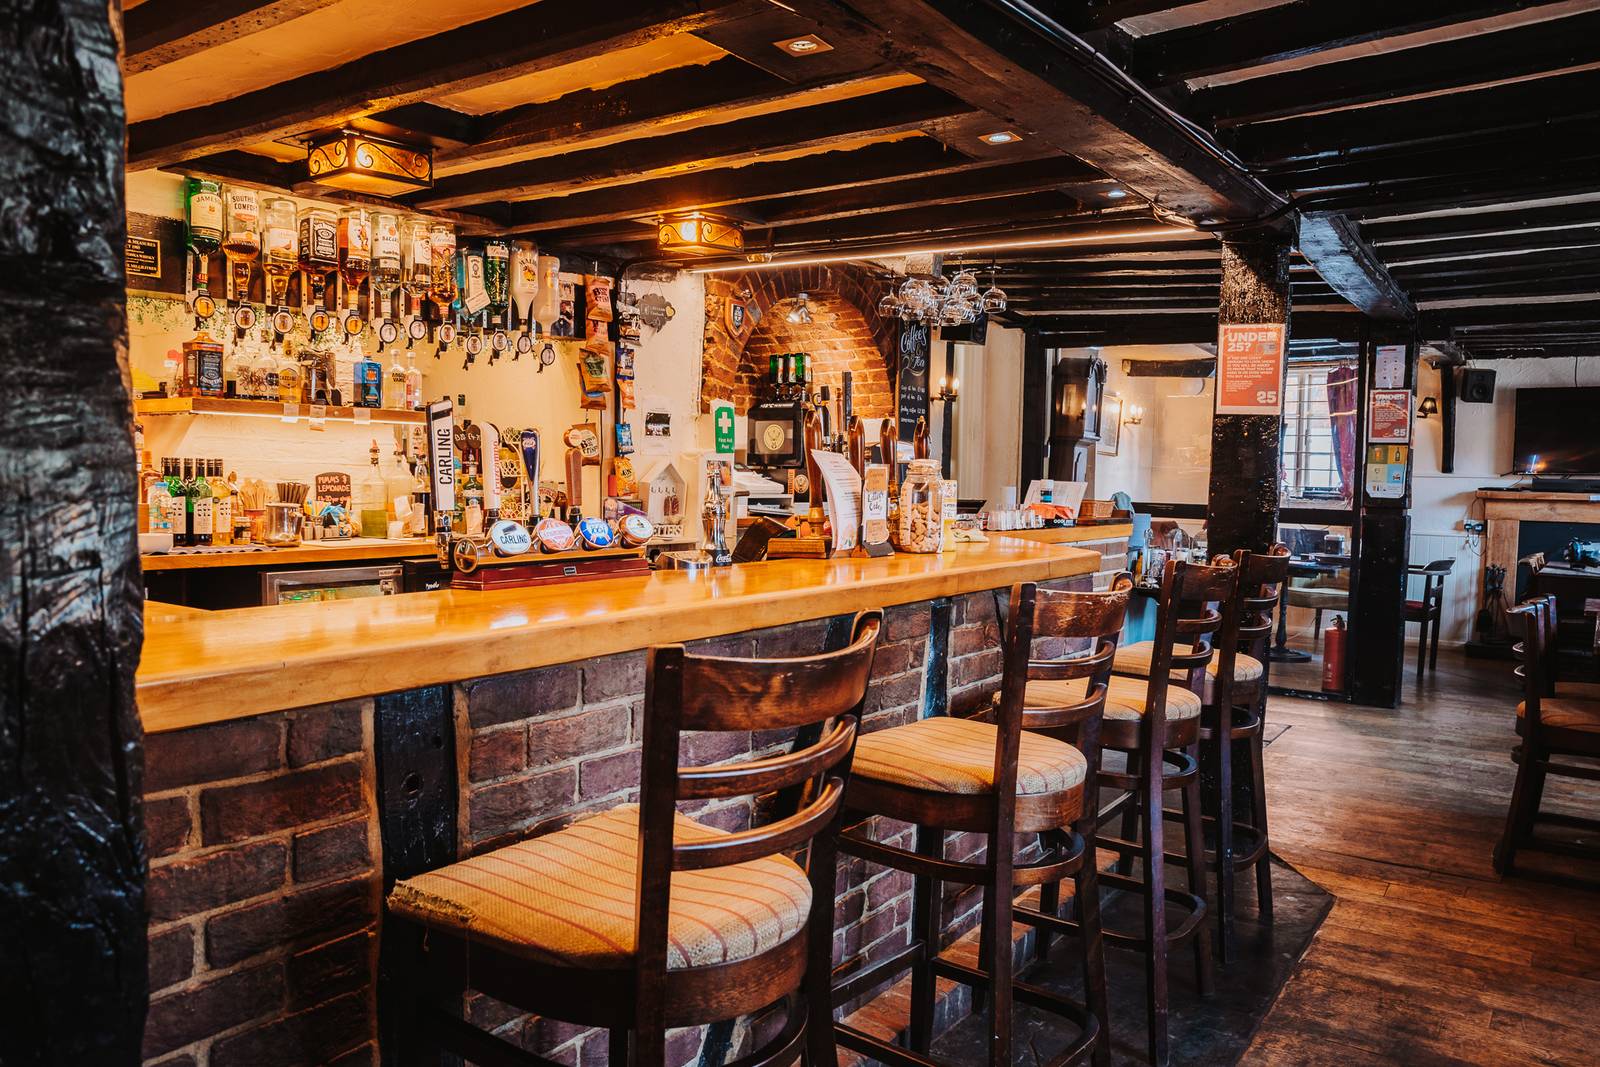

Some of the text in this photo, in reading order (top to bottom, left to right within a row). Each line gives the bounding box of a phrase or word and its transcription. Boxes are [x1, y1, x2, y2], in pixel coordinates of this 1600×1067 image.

[900, 324, 927, 353] Coffees
[1228, 331, 1278, 342] UNDER
[1227, 343, 1252, 352] 25?
[1256, 390, 1277, 404] 25
[437, 428, 453, 485] CARLING
[318, 484, 351, 492] LEMONADE
[500, 533, 528, 545] CARLING
